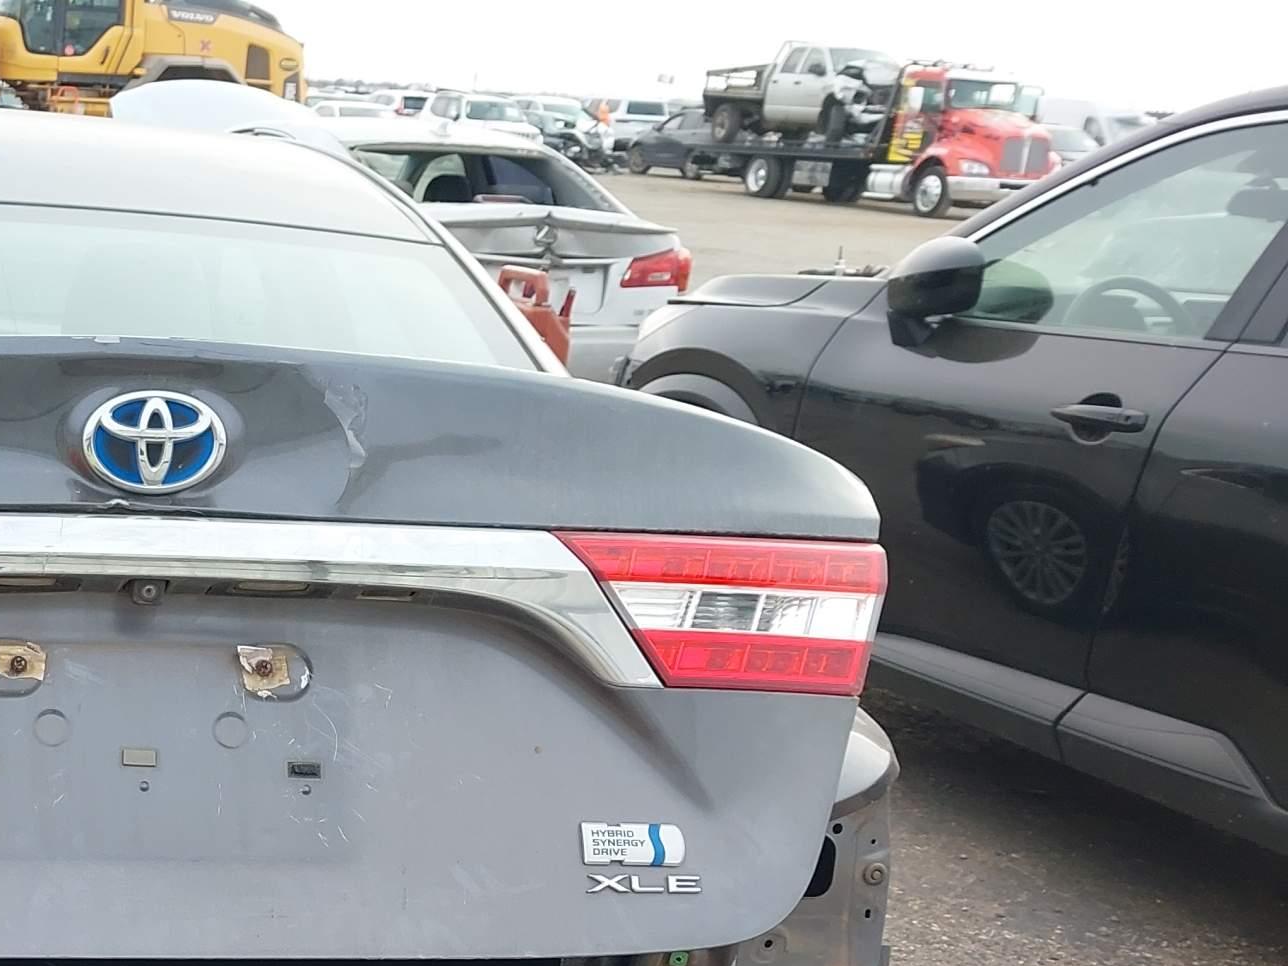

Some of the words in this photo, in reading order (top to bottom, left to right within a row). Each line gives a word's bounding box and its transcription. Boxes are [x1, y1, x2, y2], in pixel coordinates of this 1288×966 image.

[170, 10, 214, 22] VOLVO
[591, 829, 634, 838] HYBRID
[592, 838, 645, 848] SYNERGY
[593, 848, 628, 856] DRIVE
[586, 874, 702, 893] XLE
